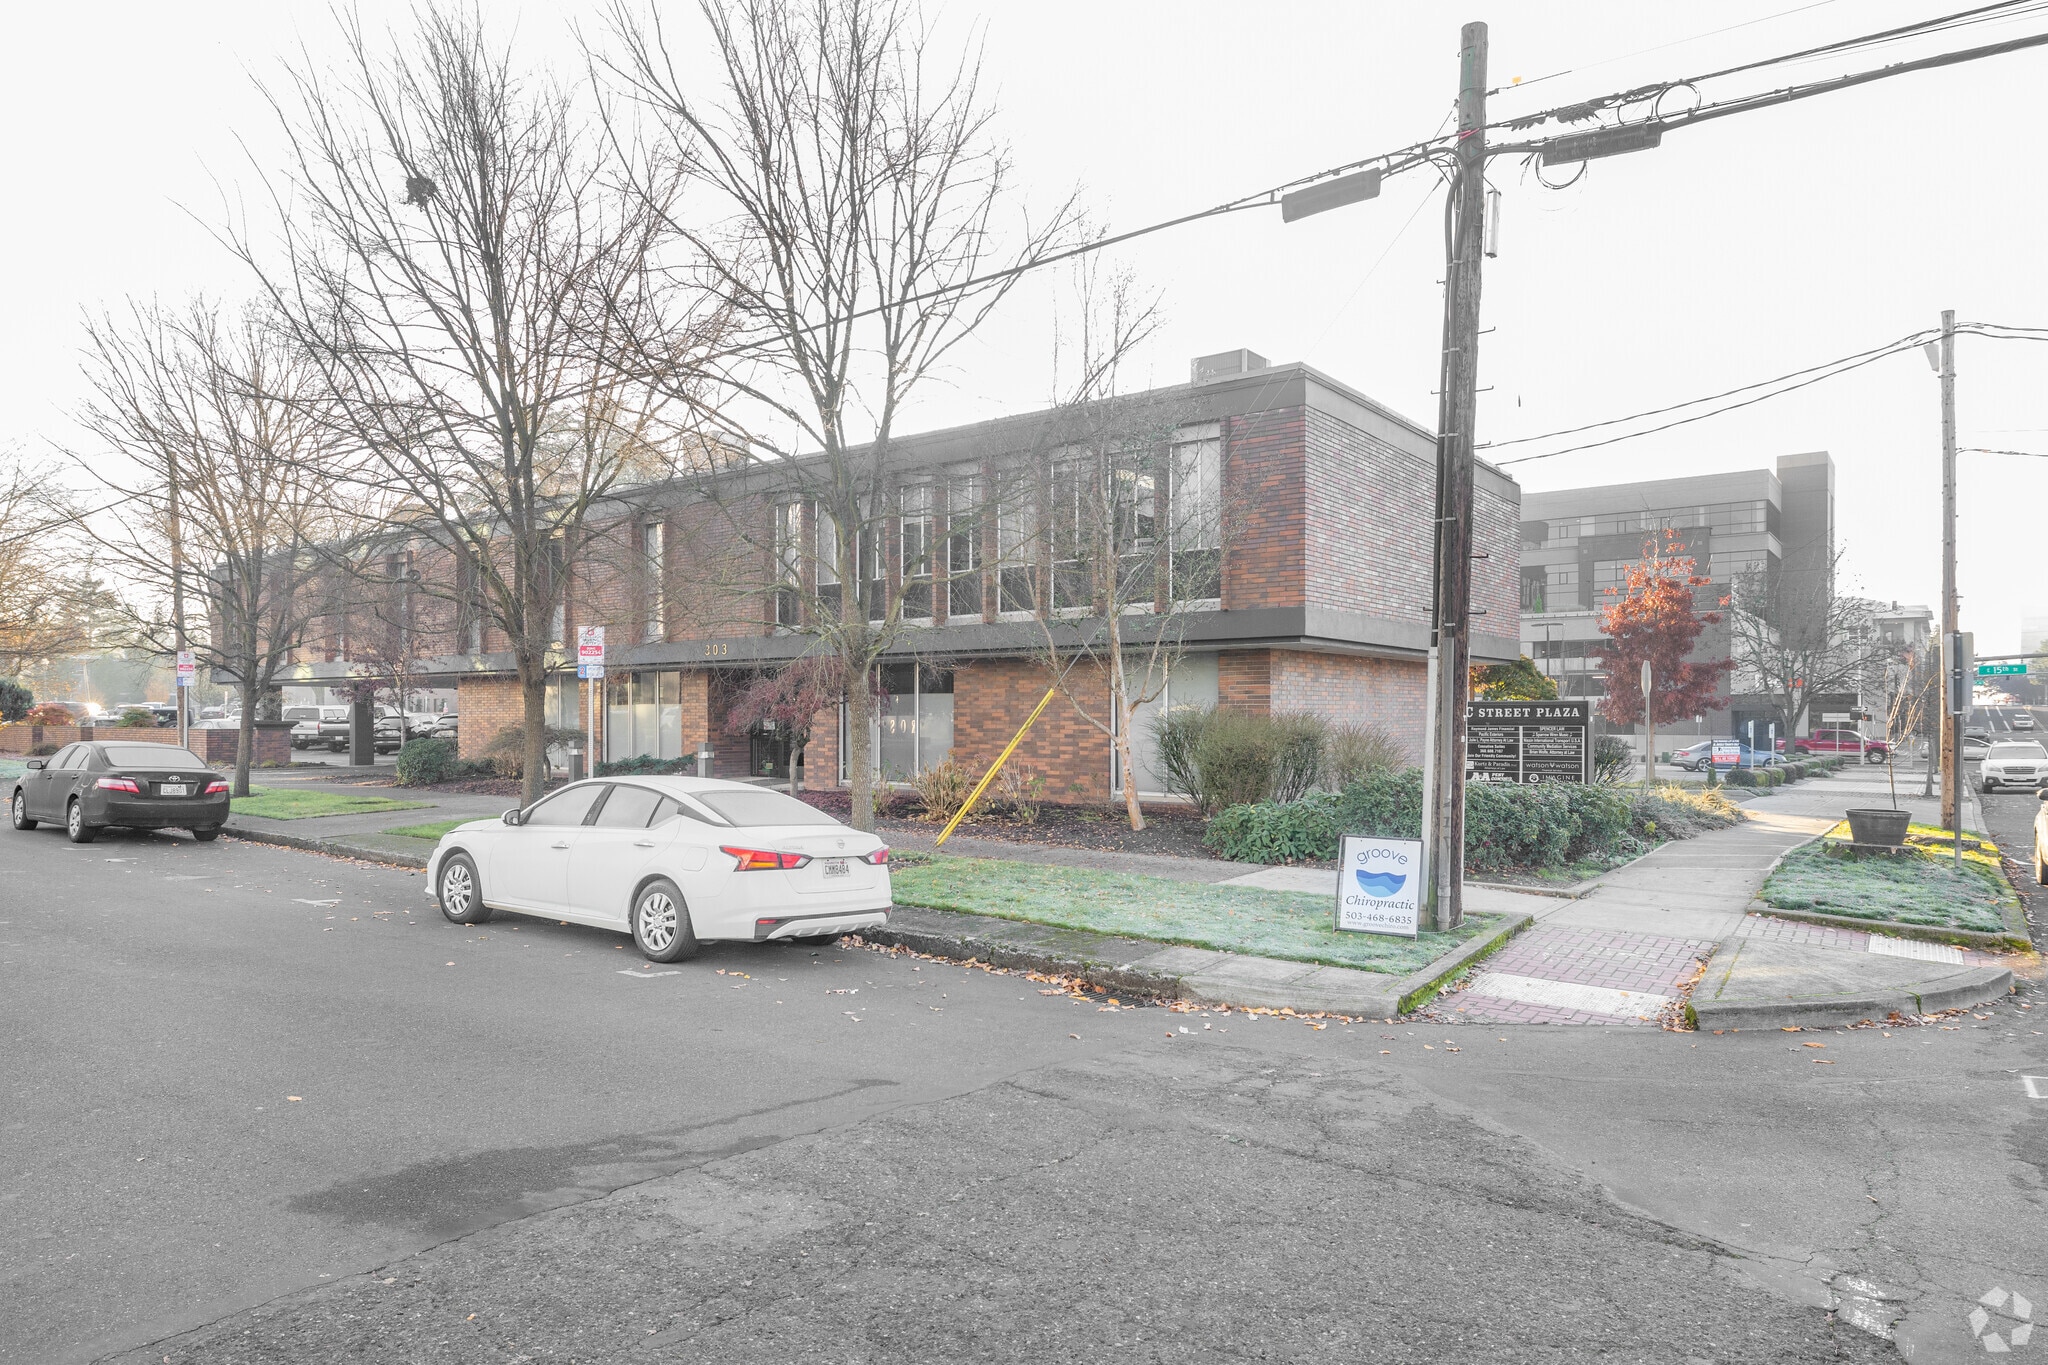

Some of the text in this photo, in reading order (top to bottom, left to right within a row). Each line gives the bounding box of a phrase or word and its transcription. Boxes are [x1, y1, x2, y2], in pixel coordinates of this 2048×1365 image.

[704, 643, 728, 656] 303
[1466, 706, 1580, 718] C STREET PLAZA
[1356, 848, 1408, 865] groove
[1346, 895, 1415, 910] Chiropractic
[1345, 911, 1412, 924] 503-468-6835
